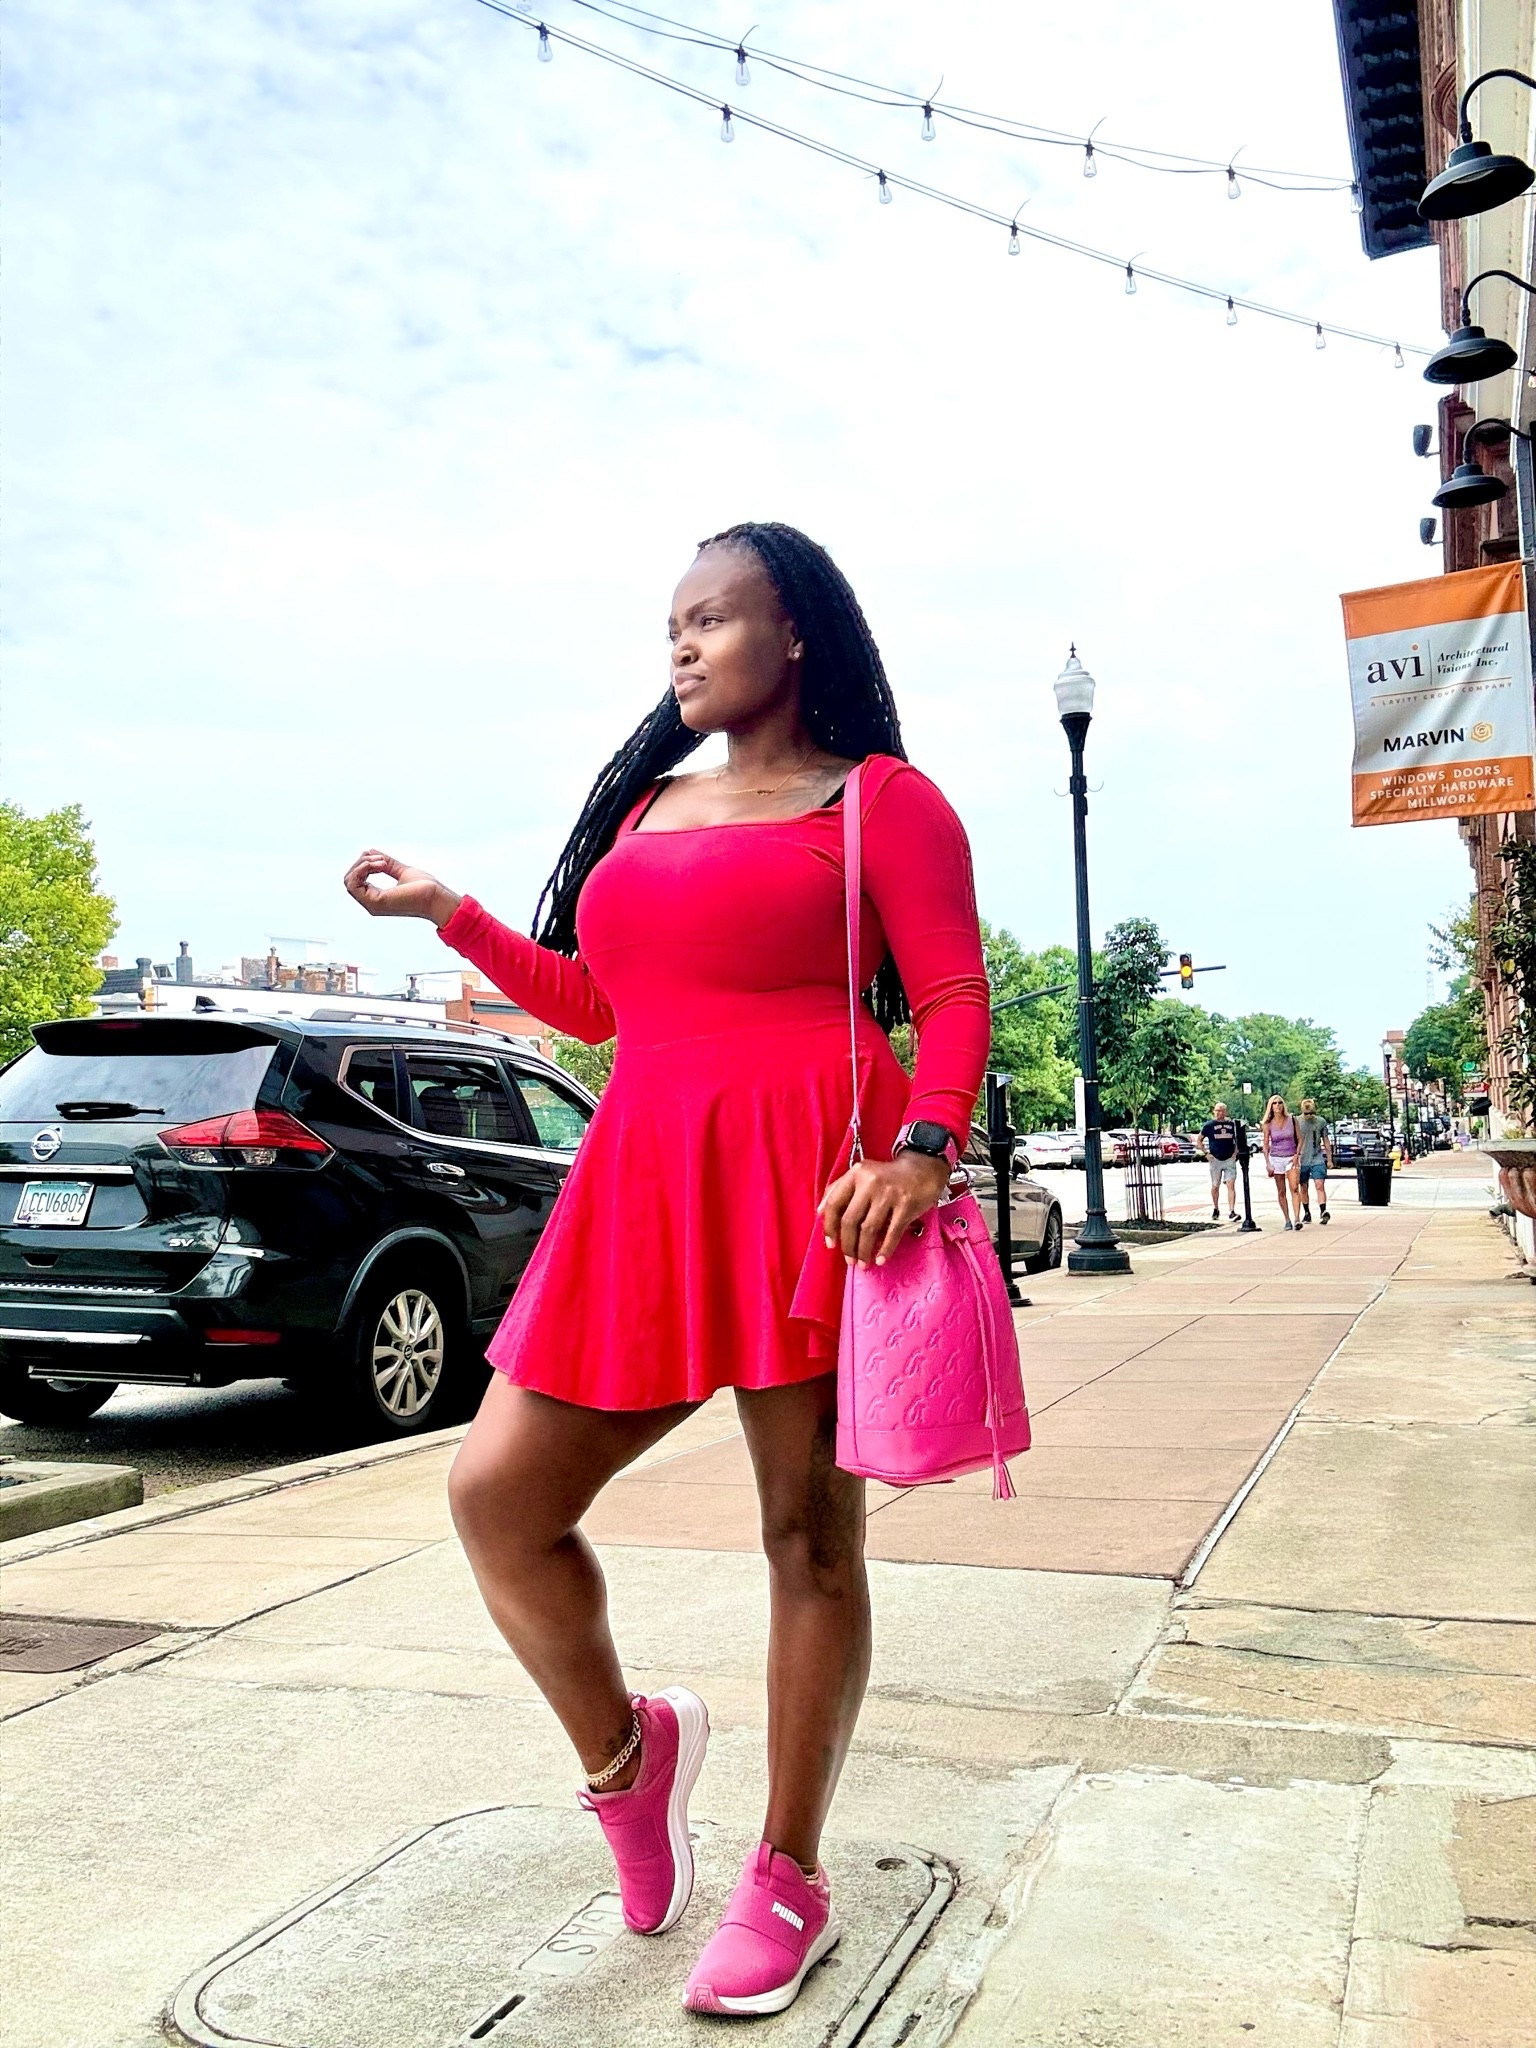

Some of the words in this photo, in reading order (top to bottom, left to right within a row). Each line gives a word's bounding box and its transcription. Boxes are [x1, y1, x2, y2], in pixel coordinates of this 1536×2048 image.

[1437, 642, 1509, 662] Architectural
[1367, 644, 1425, 684] avi
[1437, 662, 1472, 675] Visions
[1476, 657, 1498, 669] Inc.
[1382, 696, 1418, 706] LAVITY
[1423, 689, 1455, 700] GROUP
[1462, 682, 1513, 693] COMPANY
[1383, 727, 1465, 753] MARVIN
[1382, 770, 1445, 786] WINDOWS
[1453, 764, 1501, 779] DOORS
[1370, 784, 1436, 800] SPECIALTY
[1441, 776, 1514, 792] HARDWARE
[1407, 793, 1476, 809] MILLWORK
[28, 1192, 86, 1213] CCV6809
[169, 1238, 195, 1248] SV
[771, 1901, 804, 1932] PUMA
